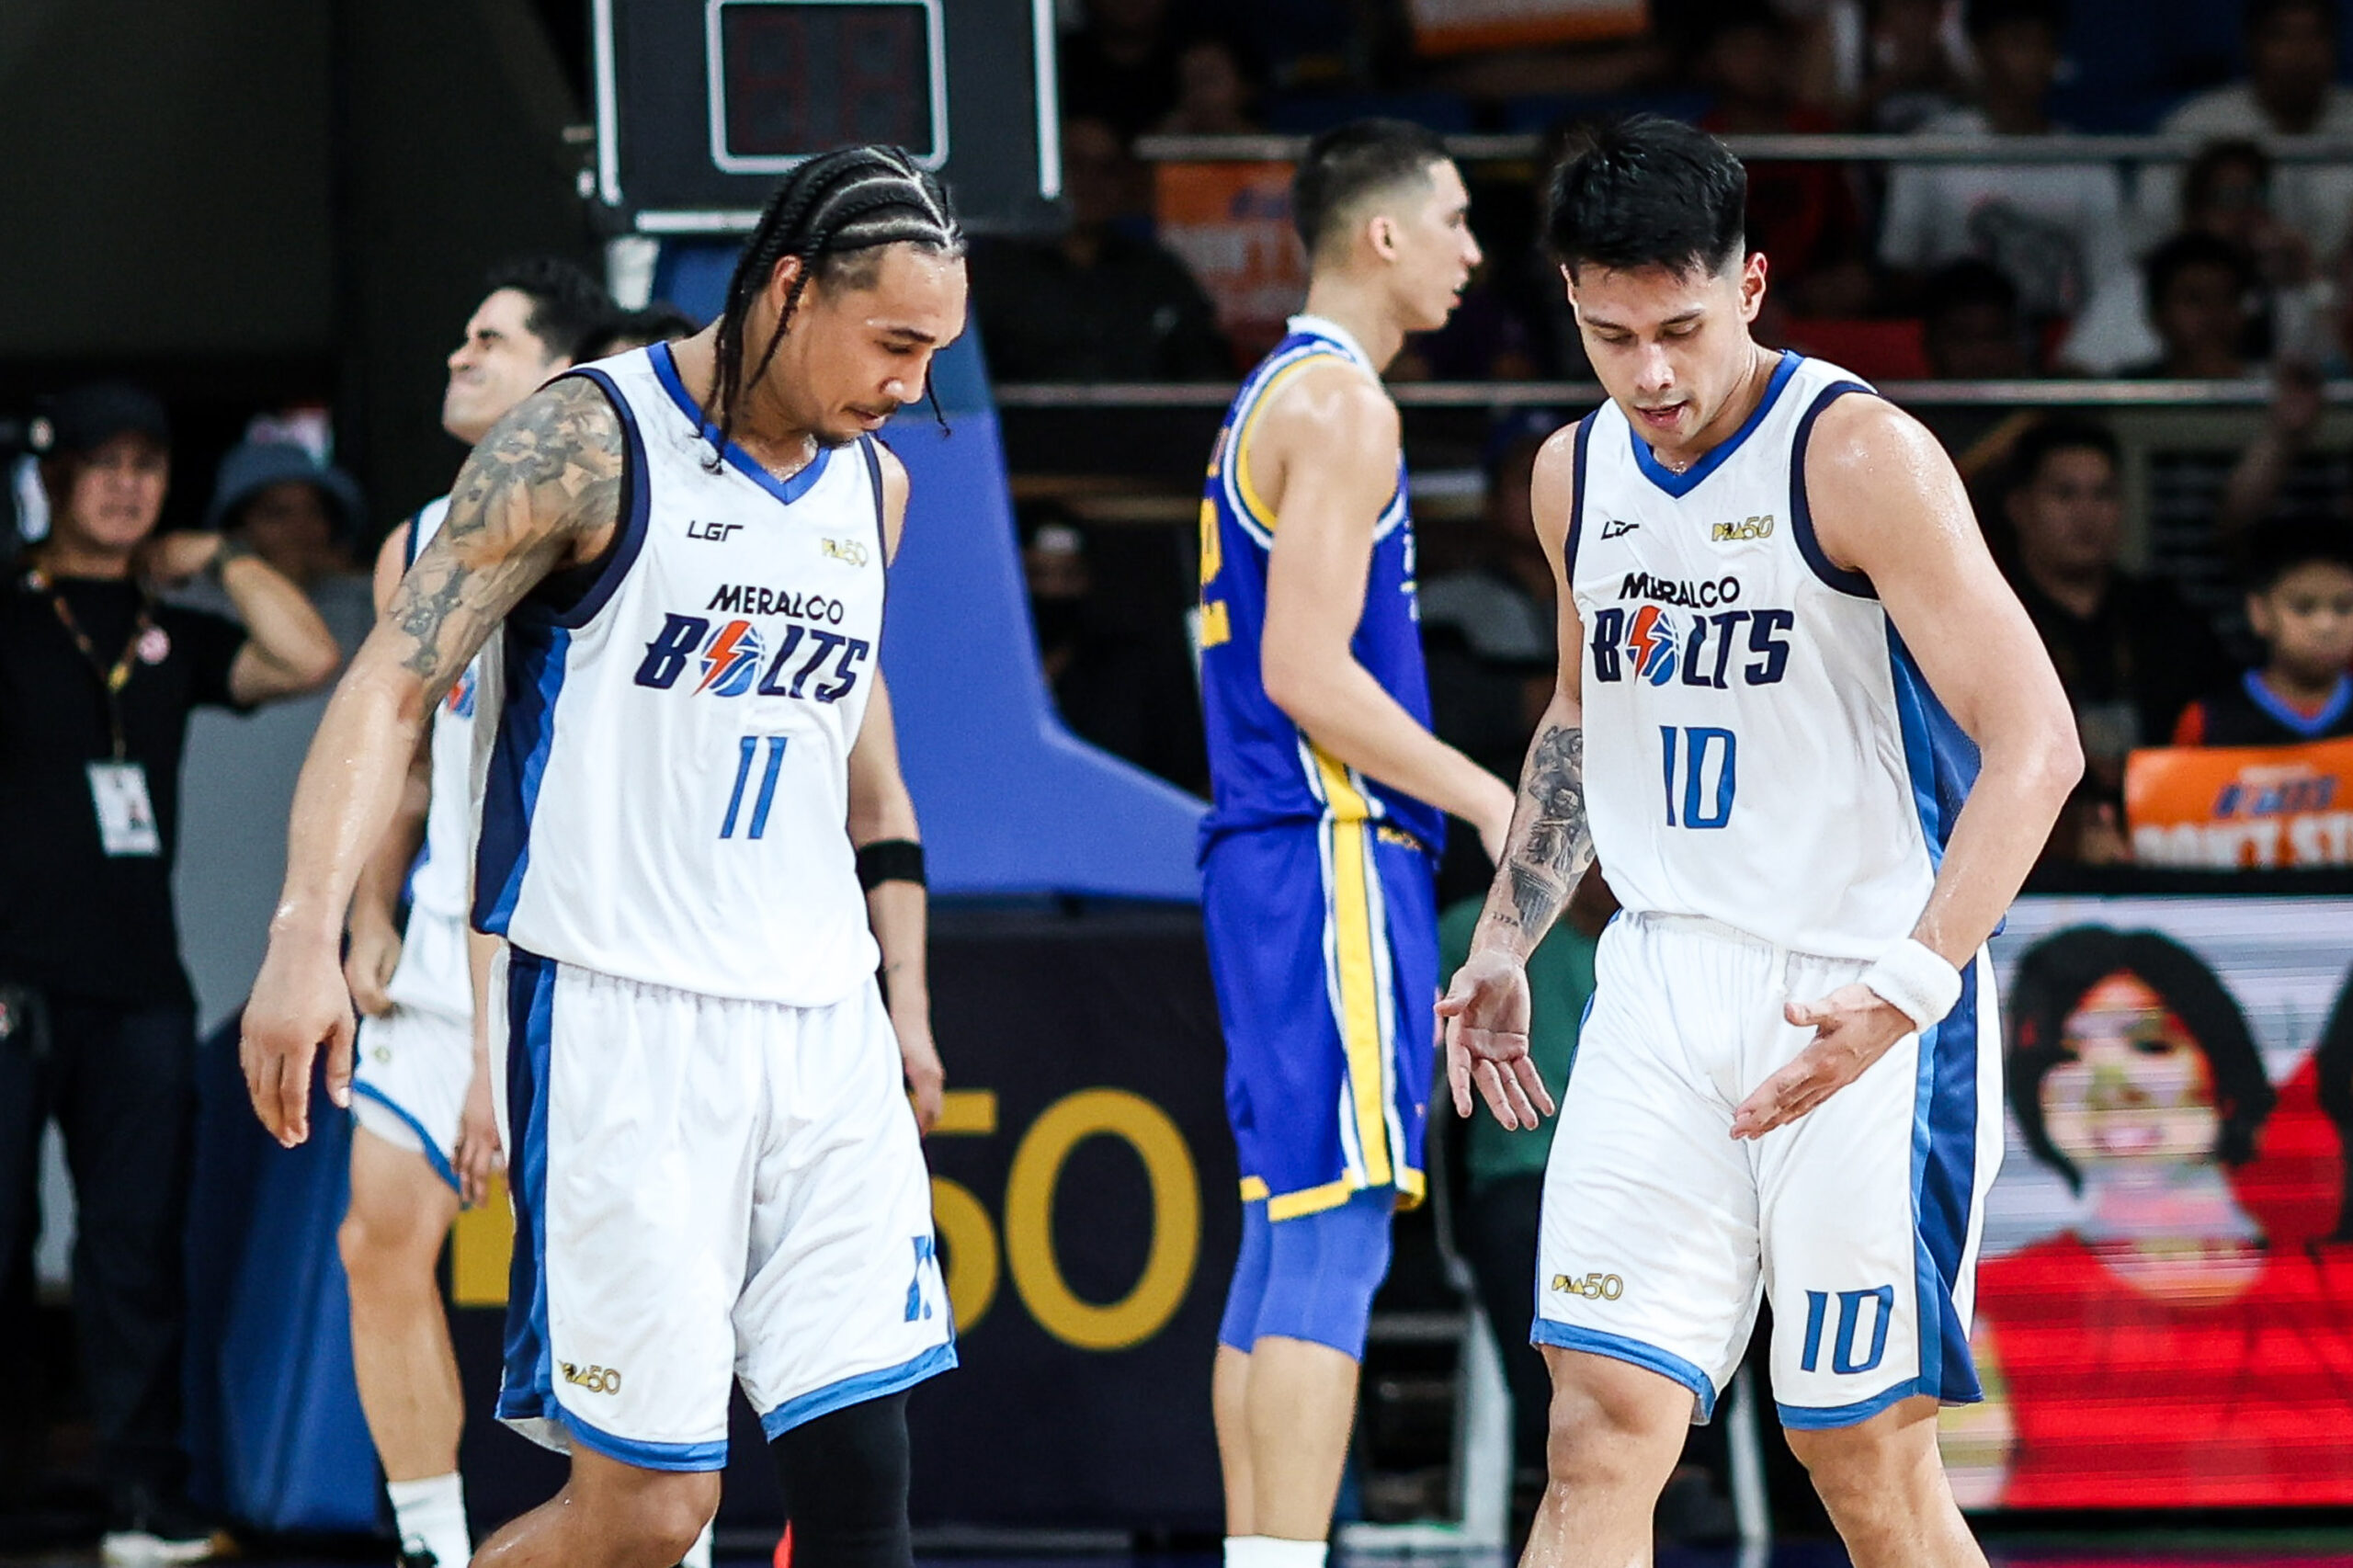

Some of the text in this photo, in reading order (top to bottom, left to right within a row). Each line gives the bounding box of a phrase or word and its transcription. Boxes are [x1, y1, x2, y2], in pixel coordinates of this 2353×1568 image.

[706, 584, 844, 625] MERALCO
[1619, 572, 1741, 608] MERALCO
[634, 613, 870, 704] BOLTS
[1589, 605, 1795, 689] BOLTS
[719, 735, 789, 839] 11
[1659, 724, 1737, 829] 10
[1801, 1284, 1894, 1375] 10
